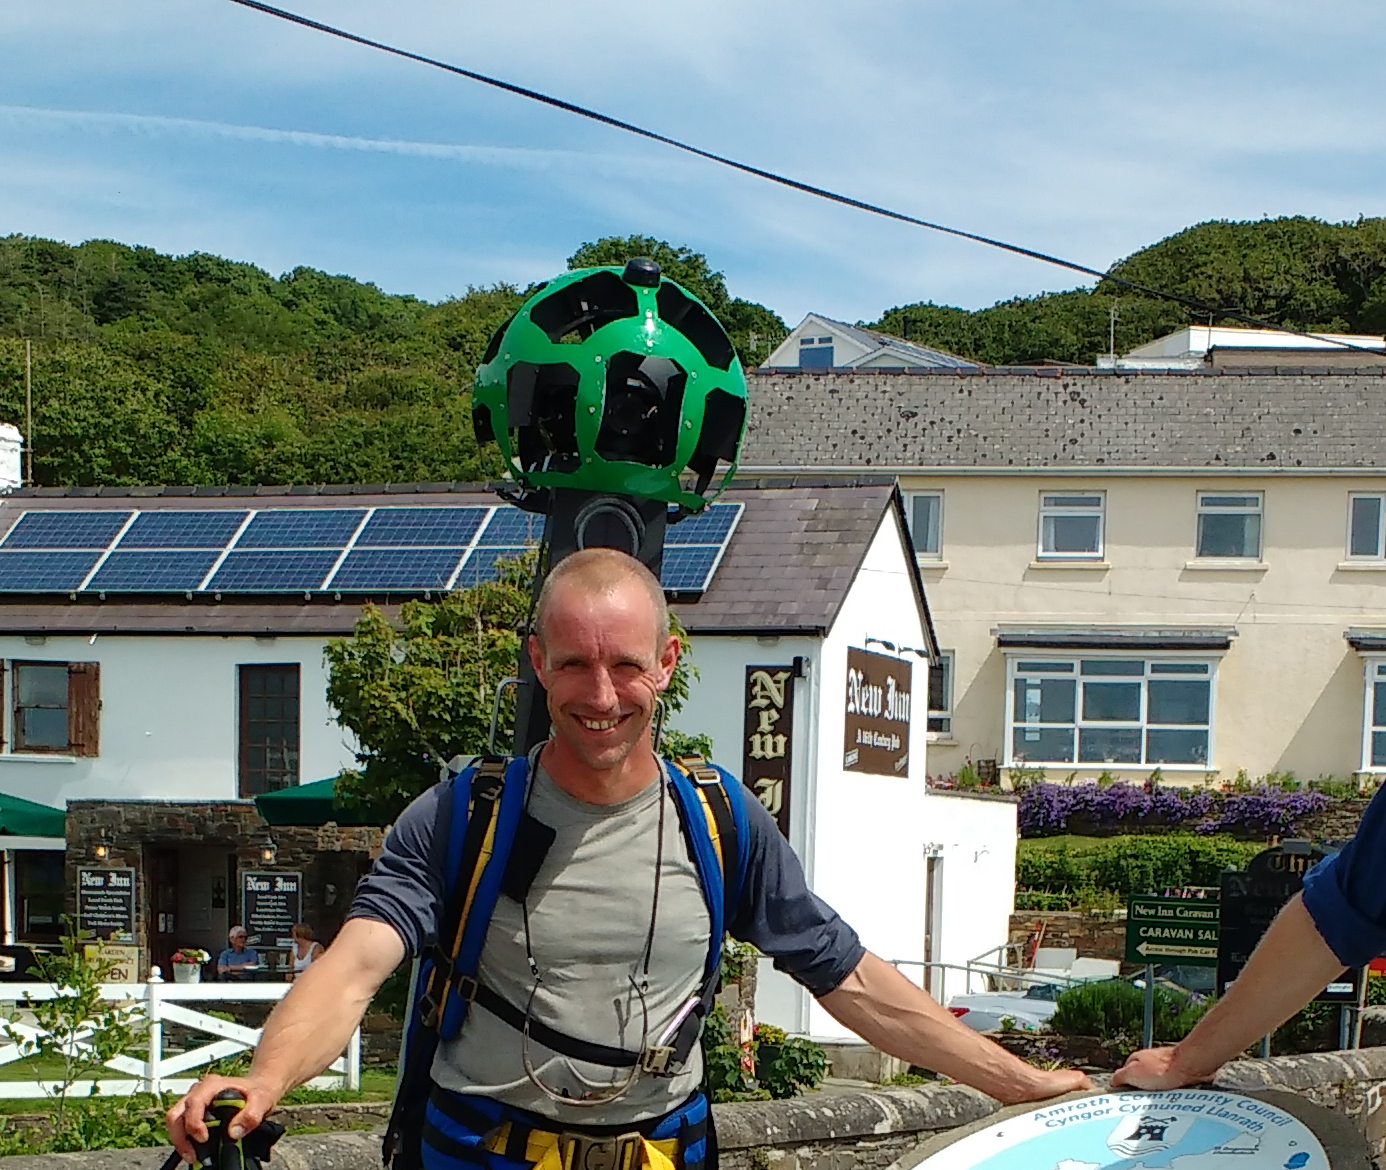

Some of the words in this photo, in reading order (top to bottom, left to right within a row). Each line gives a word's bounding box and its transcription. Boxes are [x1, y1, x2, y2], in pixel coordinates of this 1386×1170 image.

[847, 668, 882, 718] New
[884, 675, 910, 723] Inn
[81, 872, 105, 887] New
[108, 872, 131, 887] Inn
[246, 876, 271, 891] New
[274, 876, 298, 892] Inn
[1134, 905, 1156, 915] New
[1157, 906, 1174, 916] Inn
[1175, 907, 1214, 918] Caravan
[1139, 927, 1194, 940] CARAVAN
[1197, 930, 1218, 940] SAL
[1034, 1097, 1110, 1121] Amroth
[1118, 1092, 1235, 1107] Community
[1236, 1099, 1294, 1128] Council
[1045, 1107, 1113, 1128] Cyngor
[1118, 1102, 1206, 1116] Cymuned
[1207, 1106, 1264, 1132] Llanrath
